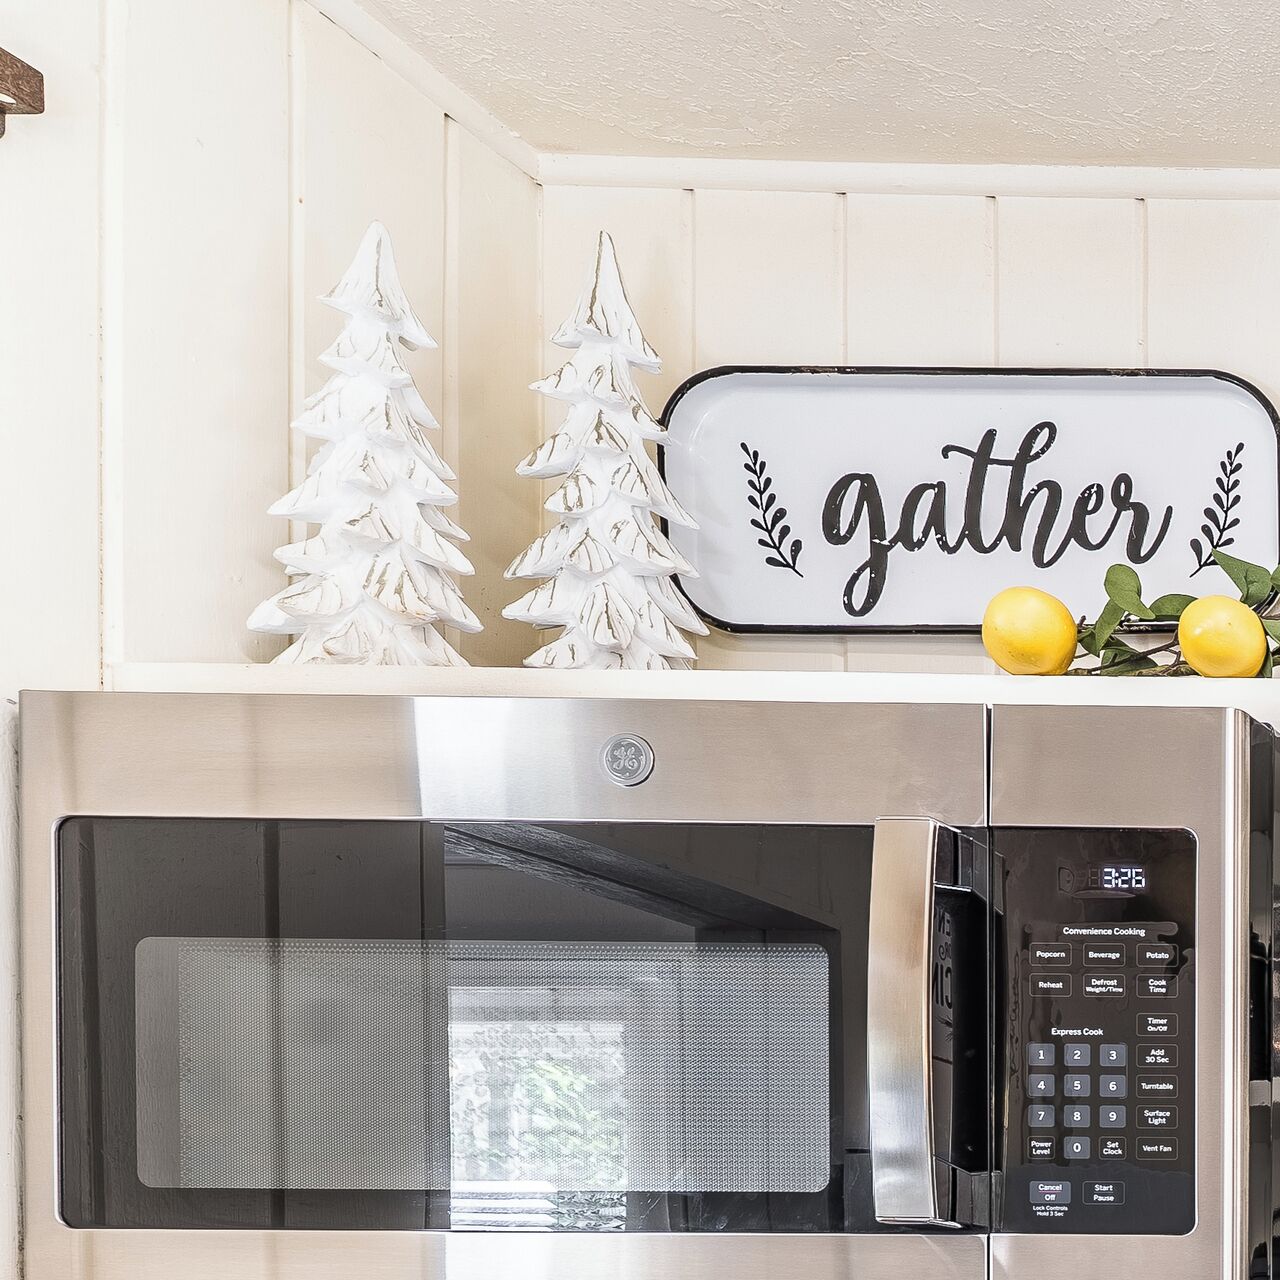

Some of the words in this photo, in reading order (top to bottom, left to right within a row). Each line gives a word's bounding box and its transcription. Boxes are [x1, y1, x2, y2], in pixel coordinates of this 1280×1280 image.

[822, 421, 1173, 617] gather
[1103, 867, 1145, 888] 3:26
[1063, 927, 1112, 936] Convenience
[1113, 927, 1146, 937] Cooking
[1036, 950, 1065, 960] Popcorn
[1088, 951, 1120, 961] Beverage
[1038, 981, 1063, 989] Reheat
[1091, 978, 1118, 986] Defrost
[1148, 978, 1167, 986] Cook
[1148, 986, 1166, 994] Time
[1147, 1017, 1167, 1025] Timer
[1051, 1028, 1081, 1037] Express
[1081, 1028, 1104, 1036] Cook
[1038, 1050, 1044, 1059] 1
[1073, 1050, 1081, 1059] 2
[1109, 1050, 1117, 1060] 3
[1145, 1056, 1155, 1064] 30
[1156, 1056, 1169, 1064] Sec
[1037, 1081, 1045, 1090] 4
[1073, 1081, 1081, 1090] 5
[1108, 1081, 1117, 1091] 6
[1141, 1082, 1173, 1090] Turntable
[1037, 1112, 1045, 1121] 7
[1073, 1112, 1081, 1121] 8
[1108, 1112, 1117, 1121] 9
[1144, 1109, 1170, 1117] Surface
[1148, 1117, 1166, 1126] Light
[1073, 1143, 1081, 1152] 0
[1106, 1141, 1119, 1149] Set
[1038, 1184, 1062, 1192] Cancel
[1094, 1184, 1113, 1192] Start
[1044, 1193, 1056, 1201] Off
